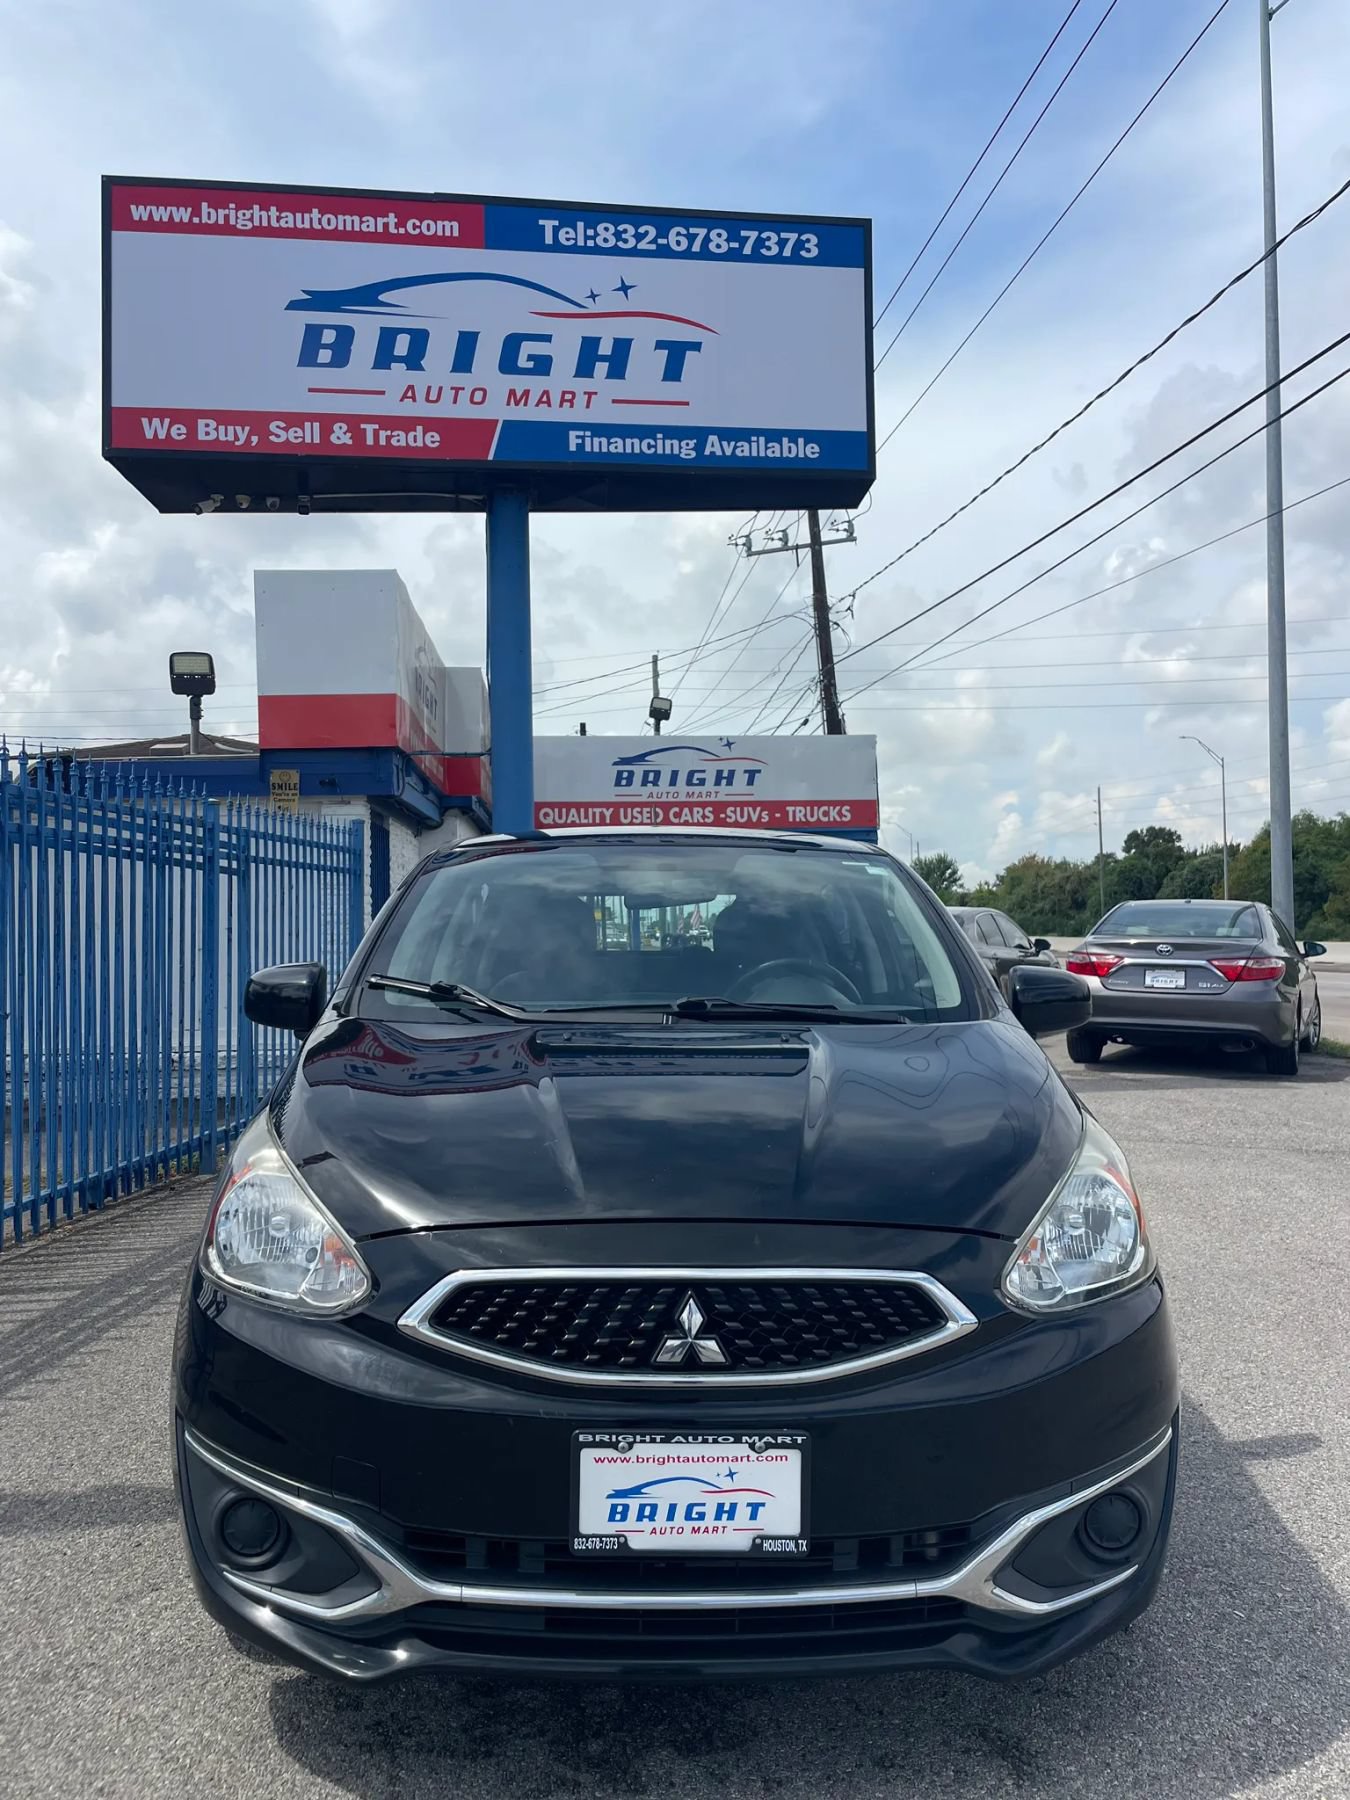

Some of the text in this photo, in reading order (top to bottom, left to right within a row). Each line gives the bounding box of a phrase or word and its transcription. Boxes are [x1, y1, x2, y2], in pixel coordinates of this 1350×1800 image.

[131, 202, 459, 237] www.brightautomart.com
[538, 219, 819, 258] Tel:832-678-7373
[296, 323, 703, 382] BRIGHT
[399, 384, 598, 409] AUTO MART
[141, 417, 441, 447] We Buy, Sell & Trade
[568, 430, 820, 459] Financing Available
[614, 769, 762, 787] BRIGHT
[647, 790, 721, 800] AUTO MART
[539, 807, 613, 825] QUALITY
[619, 807, 664, 824] USED
[669, 807, 714, 823] CARS
[786, 805, 851, 822] TRUCKS
[578, 1434, 807, 1444] BRIGHT AUTO MART
[593, 1453, 788, 1465] www.brightautomart.com
[607, 1502, 767, 1522] BRIGHT
[649, 1525, 728, 1535] AUTO MART
[573, 1537, 807, 1552] 832-678-7373 HOUSTON, TX
